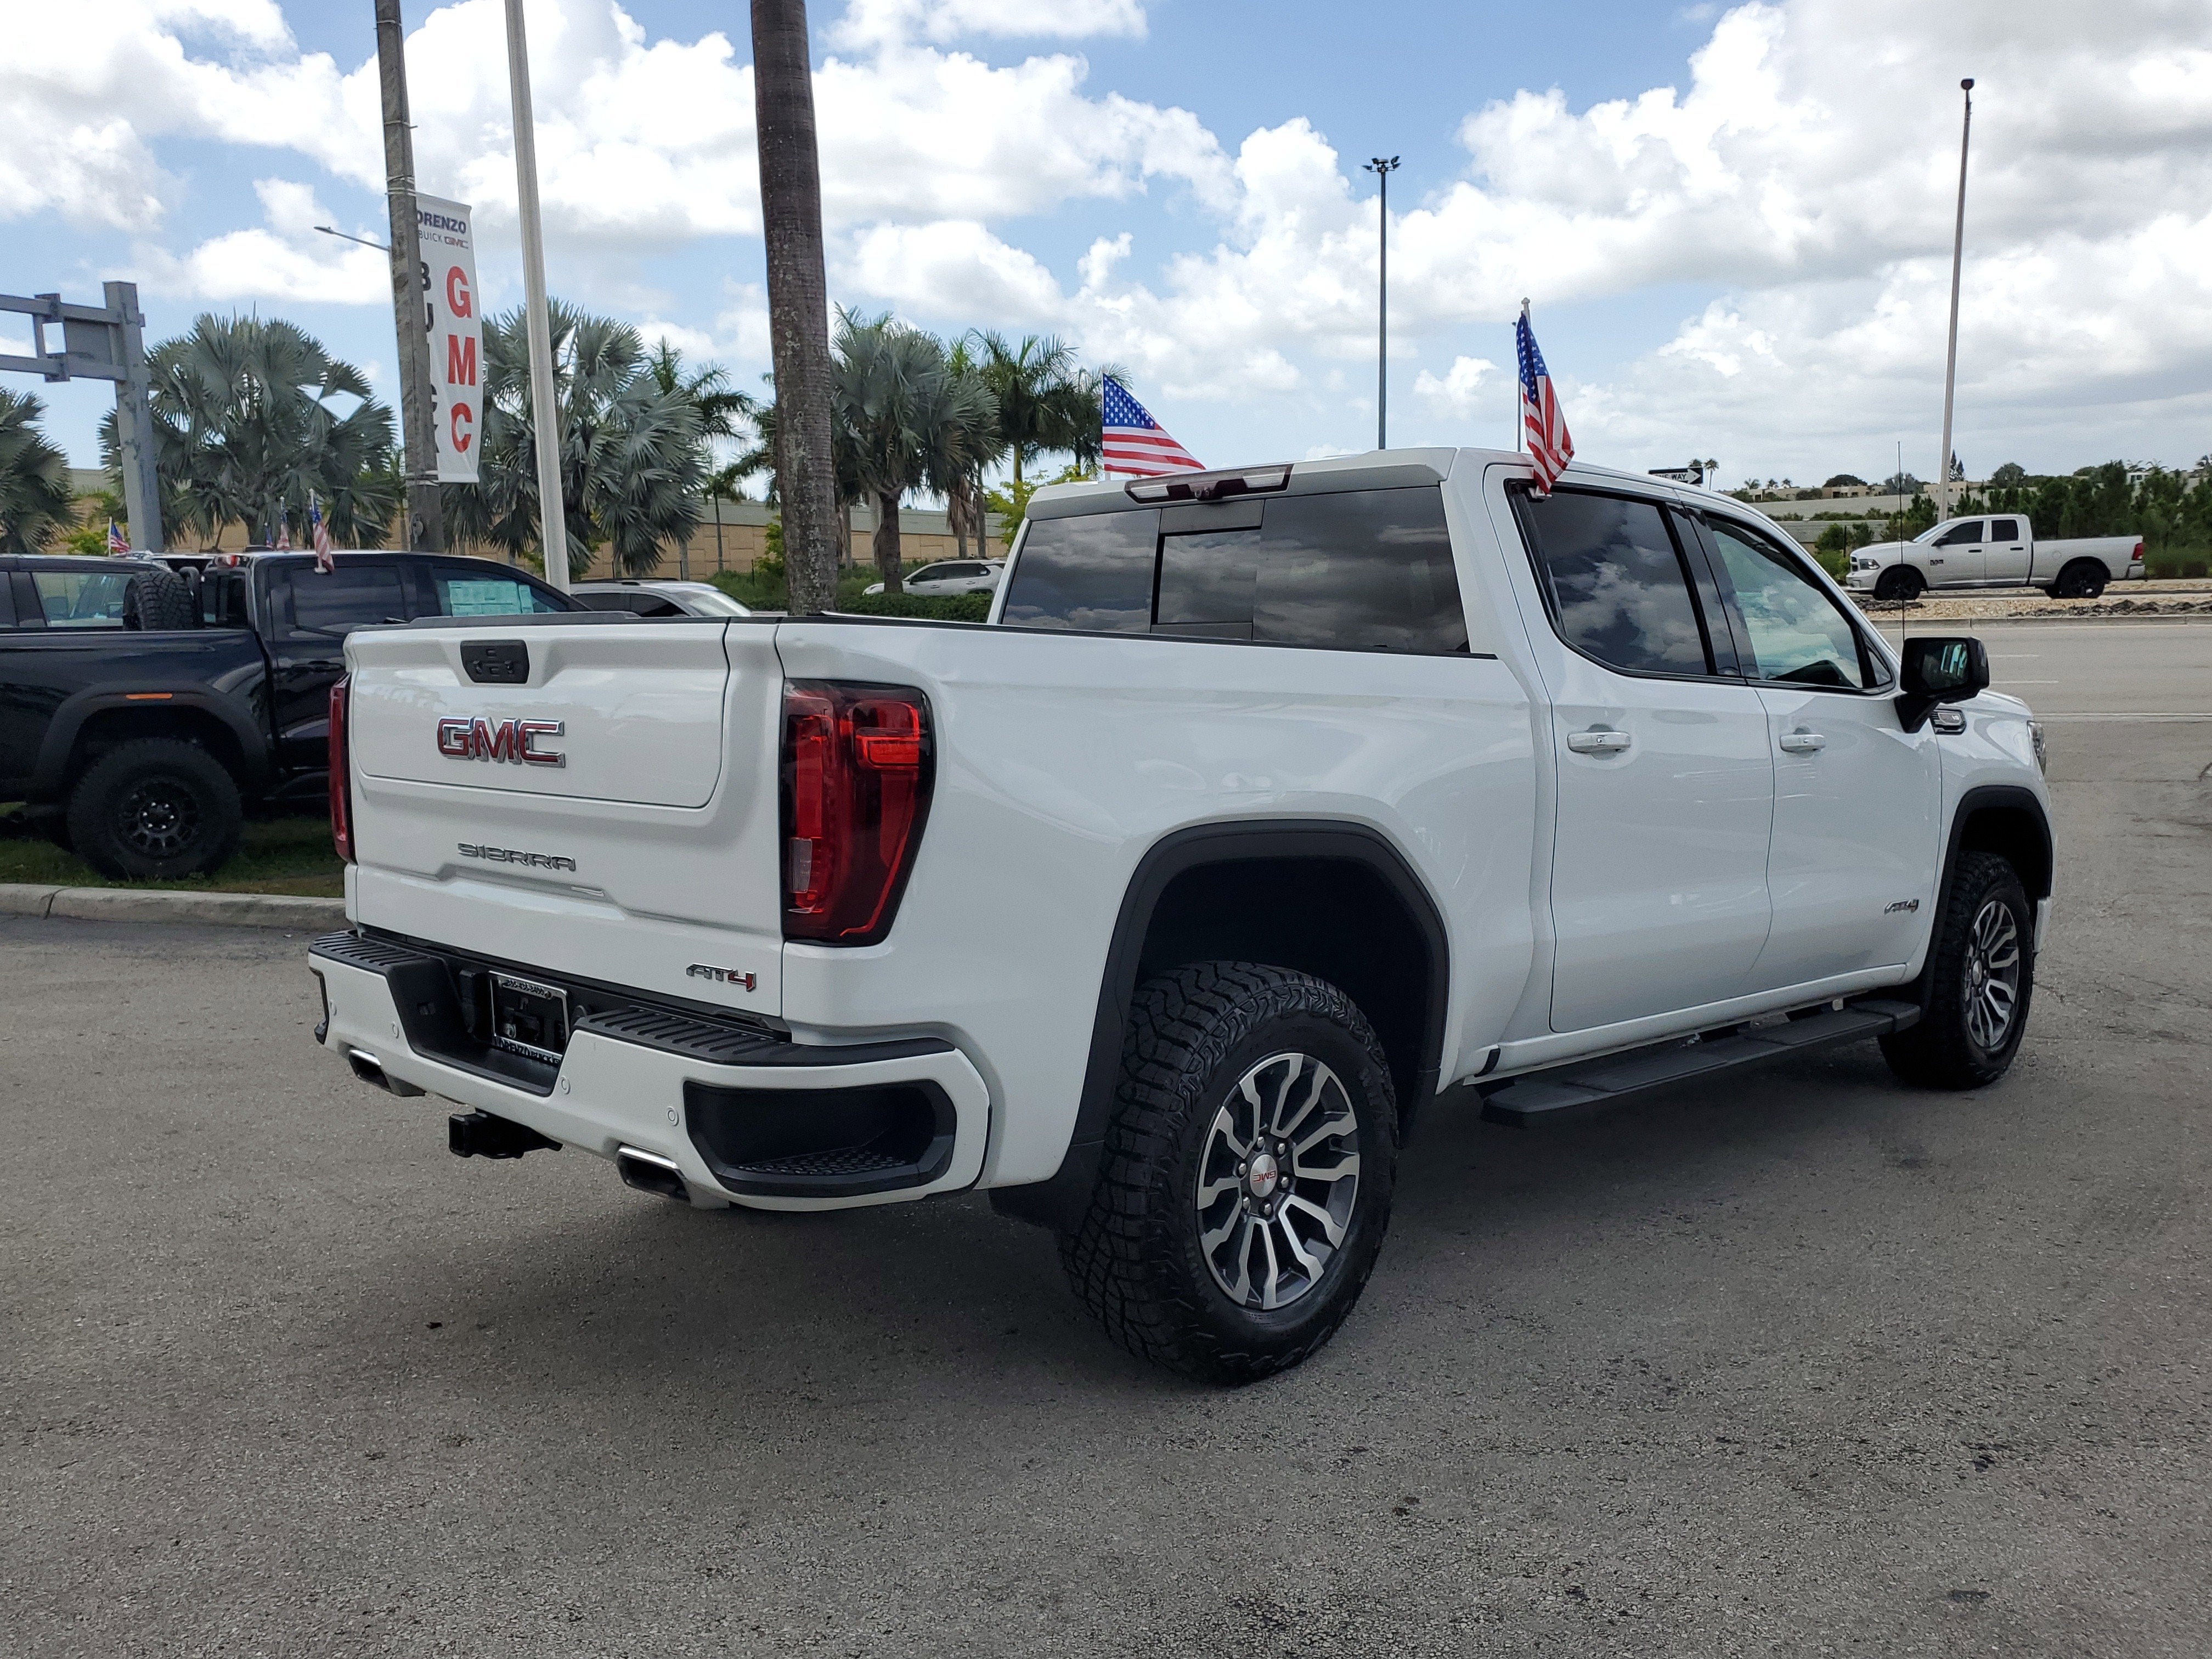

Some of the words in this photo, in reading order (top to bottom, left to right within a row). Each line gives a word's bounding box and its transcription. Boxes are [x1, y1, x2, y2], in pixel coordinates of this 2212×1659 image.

[418, 230, 442, 242] BUICK
[444, 236, 469, 249] GMC
[447, 266, 476, 453] GMC
[437, 715, 566, 768] GMC
[458, 843, 576, 872] SIERRA
[1884, 899, 1919, 915] AT4
[686, 962, 757, 992] AT4
[1252, 1170, 1276, 1182] GMC
